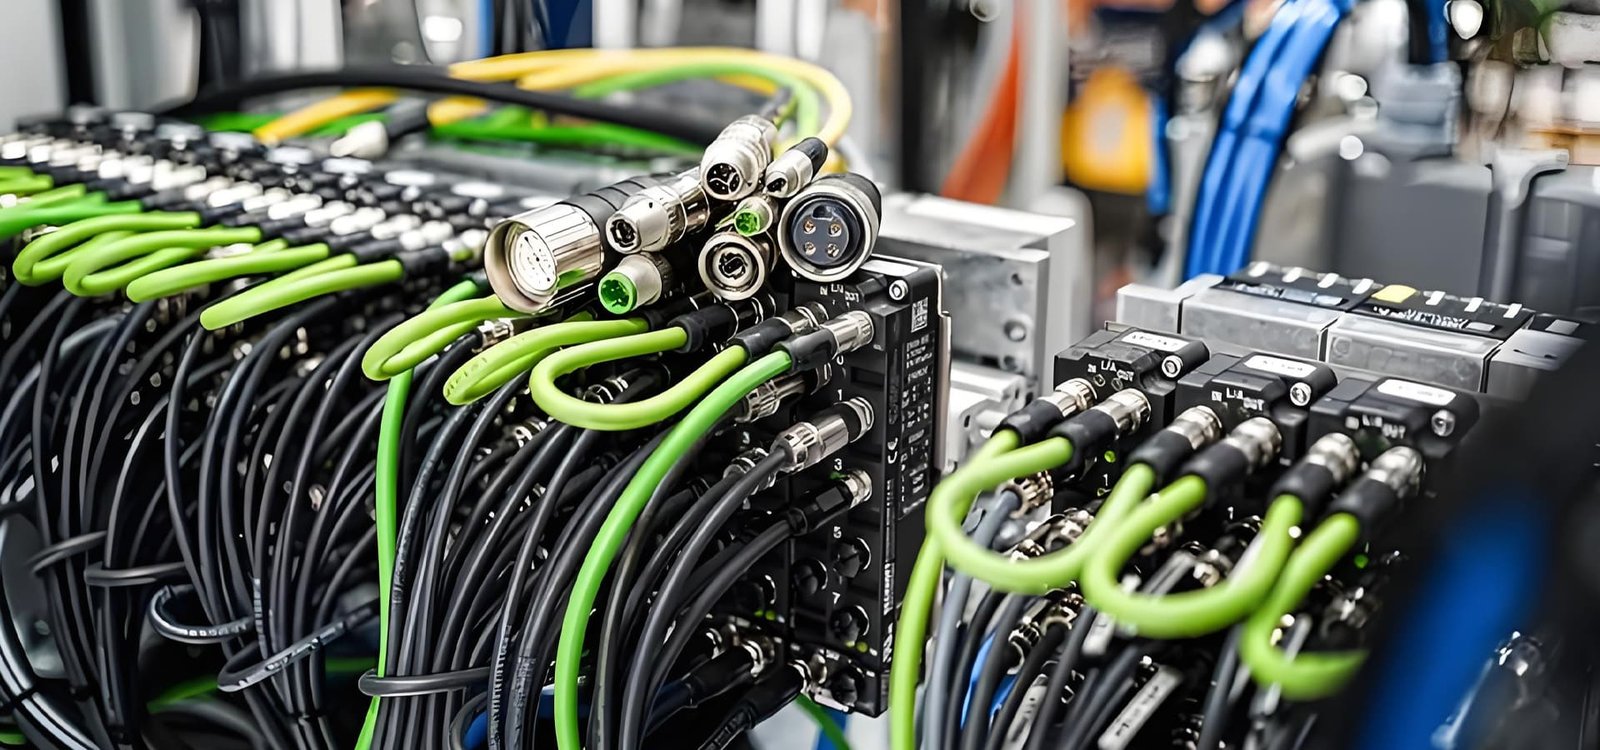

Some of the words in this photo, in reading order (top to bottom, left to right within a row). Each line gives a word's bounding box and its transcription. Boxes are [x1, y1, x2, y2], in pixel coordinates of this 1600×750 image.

[837, 388, 843, 402] 1
[833, 457, 843, 472] 3
[1102, 473, 1109, 487] 1
[833, 525, 843, 539] 5
[831, 591, 842, 605] 7
